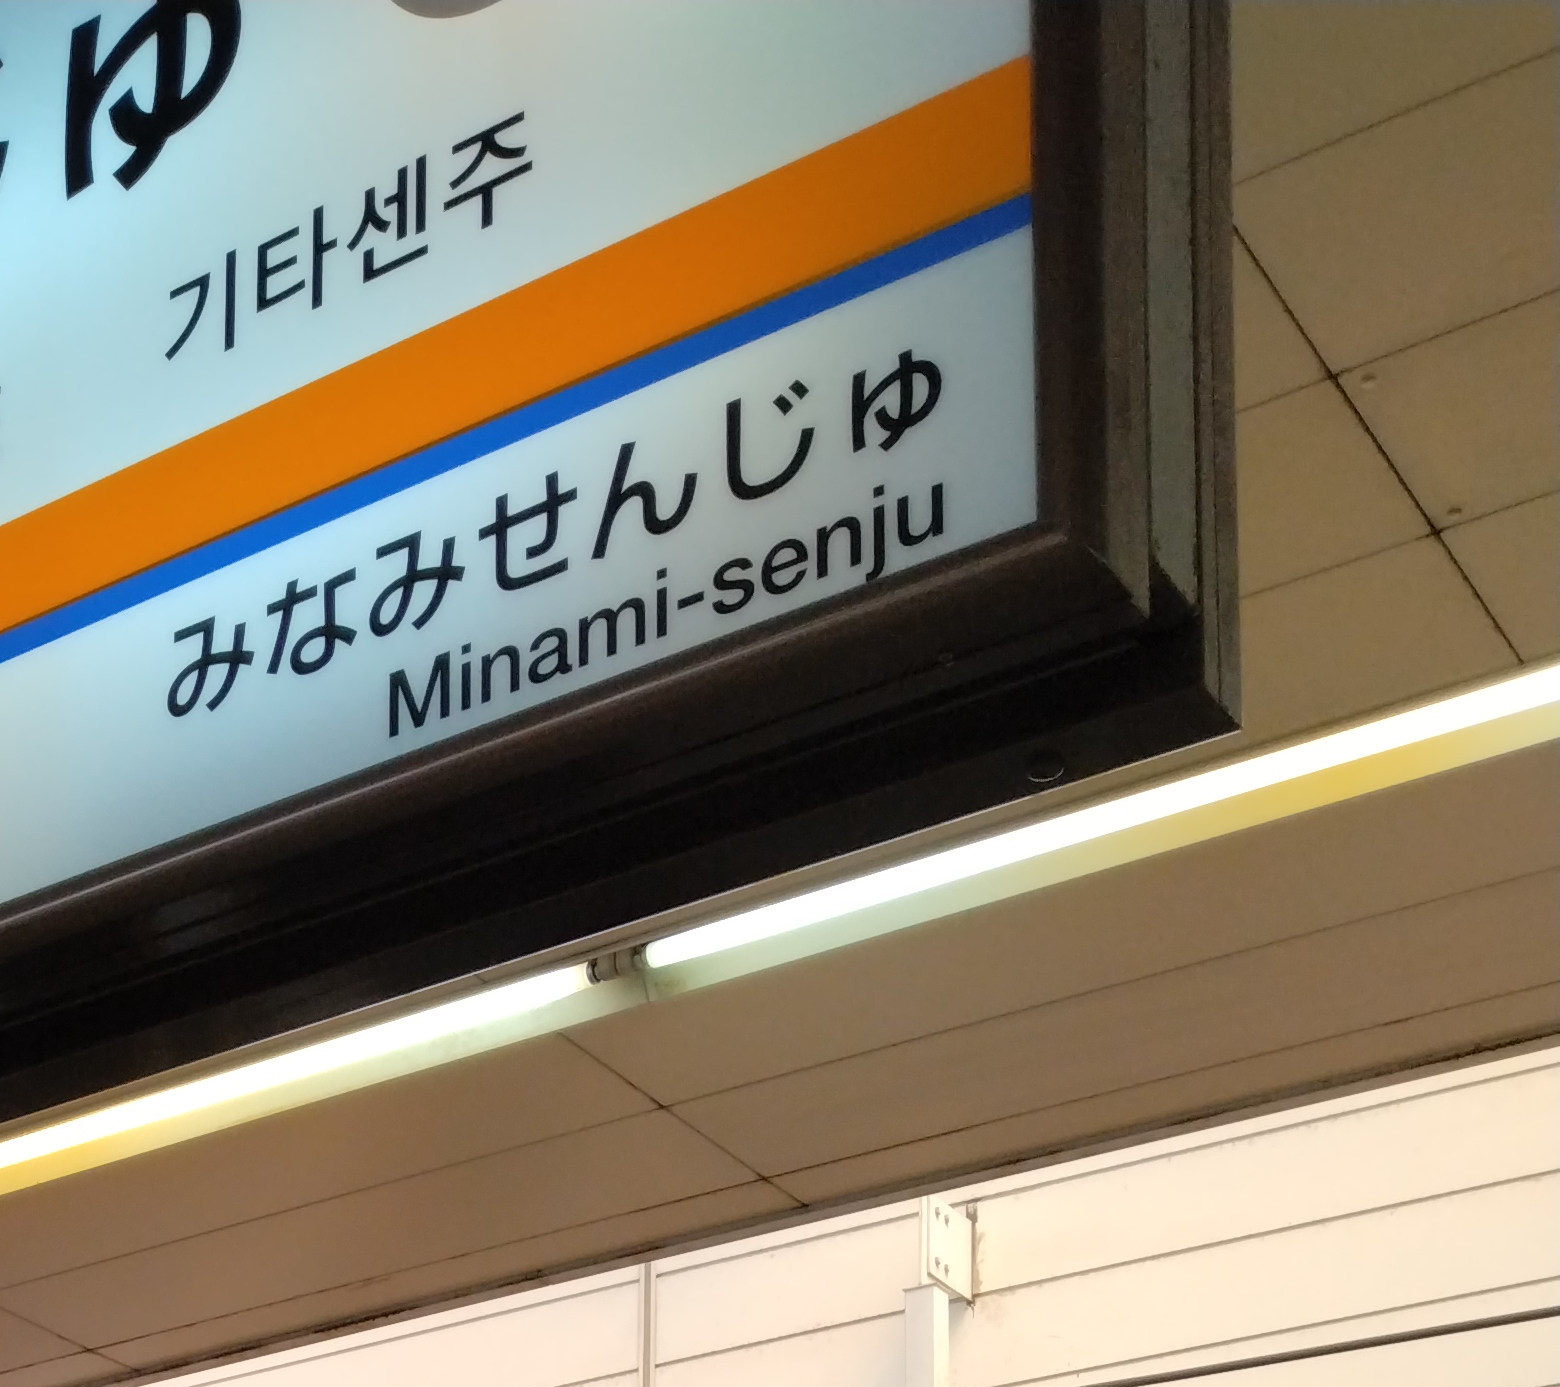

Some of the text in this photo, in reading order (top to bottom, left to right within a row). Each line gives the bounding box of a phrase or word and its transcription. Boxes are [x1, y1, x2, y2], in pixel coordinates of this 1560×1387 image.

[164, 110, 535, 360] 기타센주
[165, 348, 945, 718] みなみせんじゅ
[388, 480, 946, 739] Minami-senju
